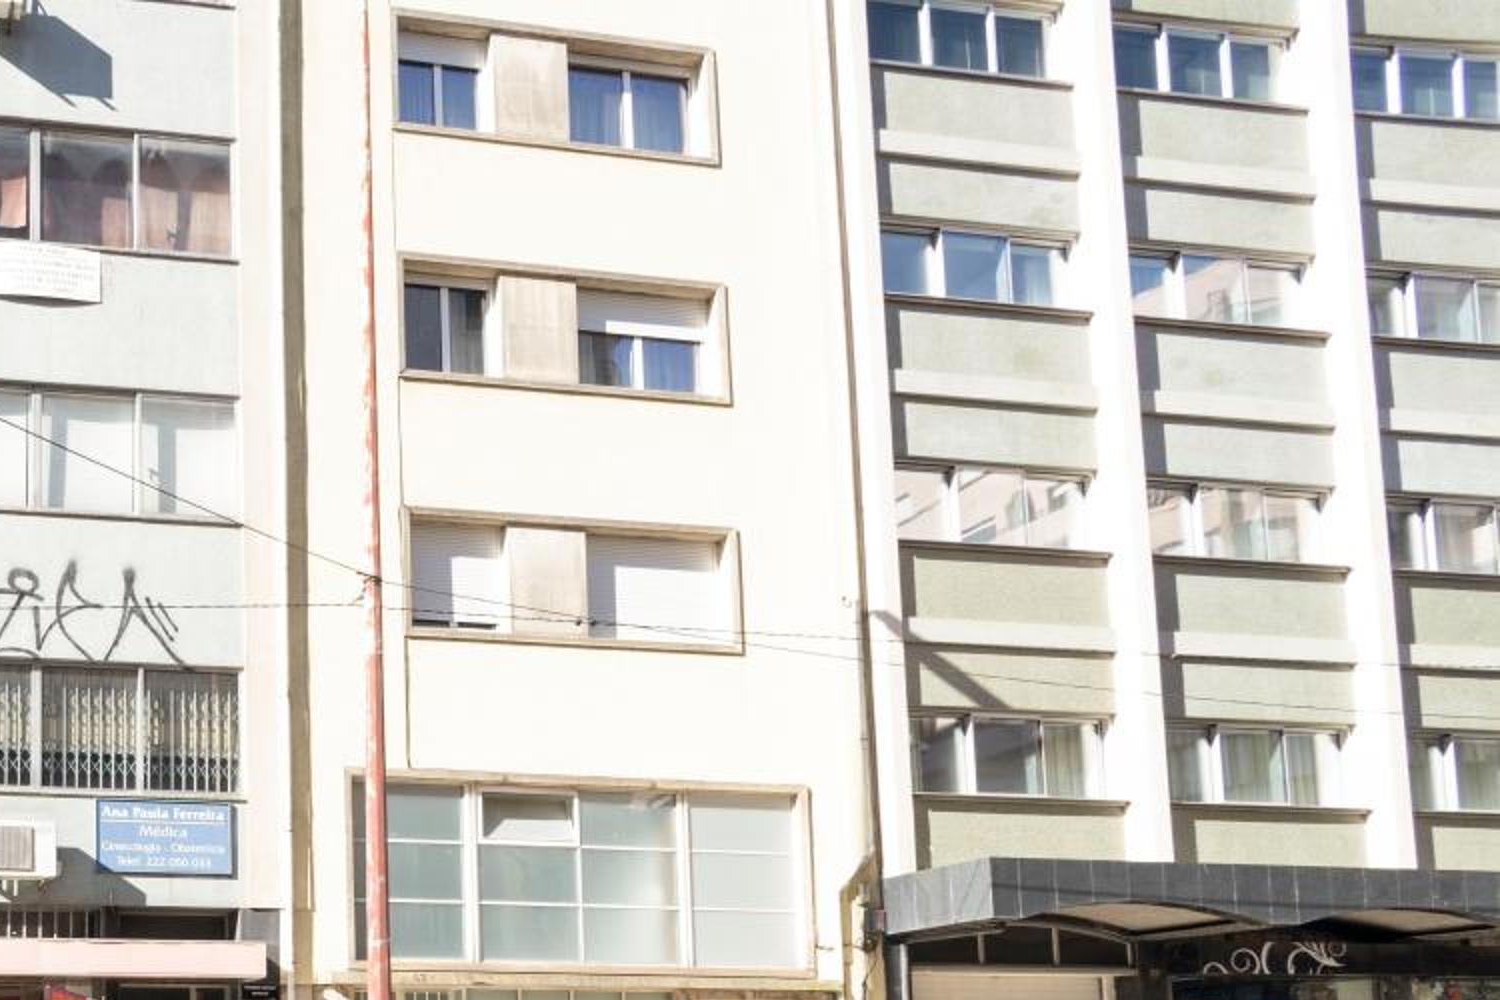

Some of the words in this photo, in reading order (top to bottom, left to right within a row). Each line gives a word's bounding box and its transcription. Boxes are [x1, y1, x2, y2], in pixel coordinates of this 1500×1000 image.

[101, 805, 129, 817] Ana
[132, 806, 169, 819] Paula
[173, 807, 226, 821] Ferreira
